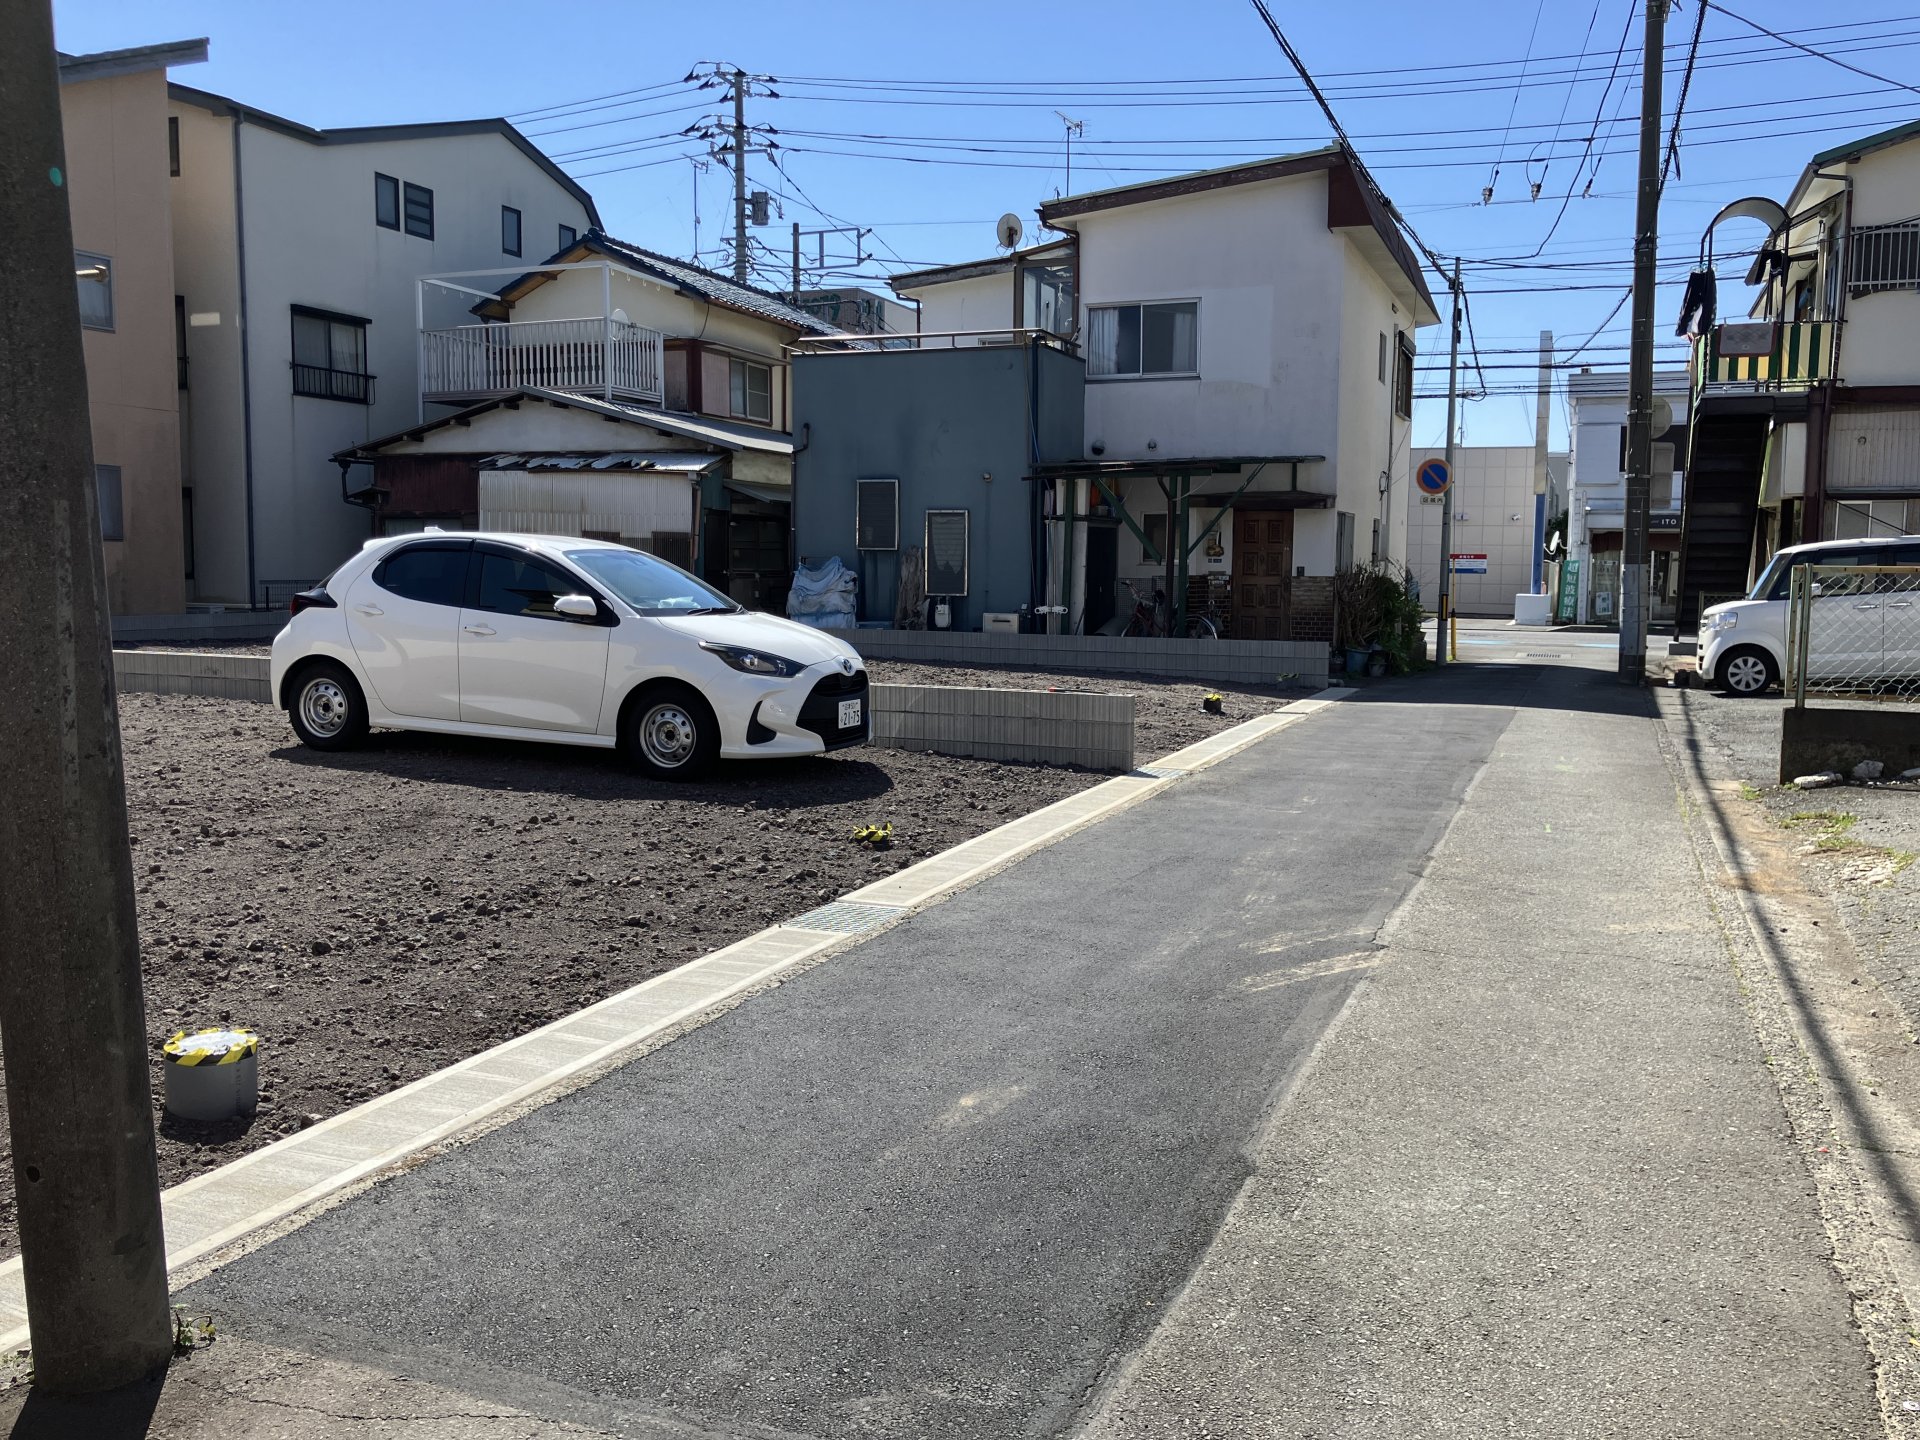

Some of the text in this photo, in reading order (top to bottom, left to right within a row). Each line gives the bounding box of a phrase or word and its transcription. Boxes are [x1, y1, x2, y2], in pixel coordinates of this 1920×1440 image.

[1422, 496, 1443, 504] 区域内
[1562, 561, 1579, 617] 超短波療法
